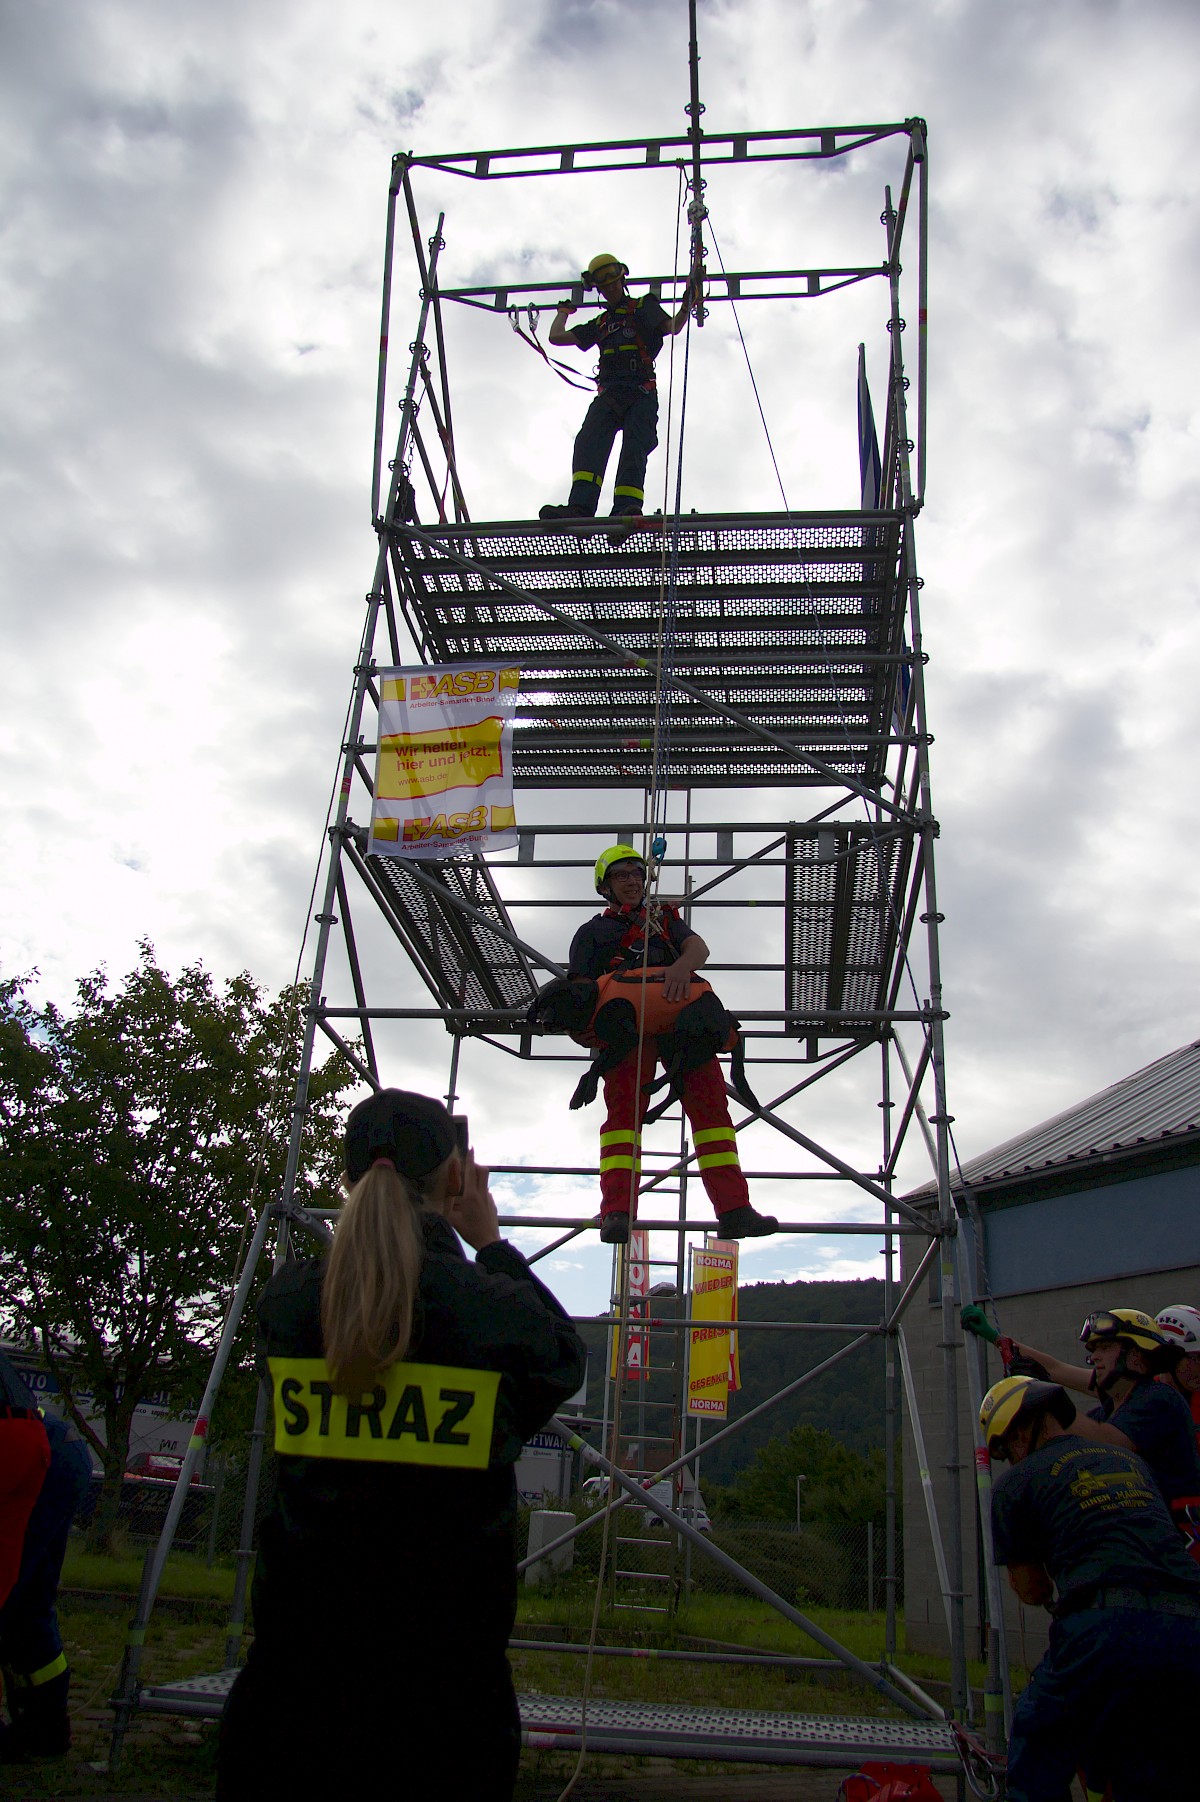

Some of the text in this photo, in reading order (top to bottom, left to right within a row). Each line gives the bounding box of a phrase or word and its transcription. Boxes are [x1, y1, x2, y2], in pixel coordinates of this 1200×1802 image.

[430, 670, 497, 698] ASB
[410, 696, 495, 709] Arbeiter-Samariter-Bund
[395, 740, 467, 758] Wir helfen
[397, 747, 491, 771] hier und jetzt.
[398, 773, 447, 786] www.asb.de
[421, 805, 489, 840] ASB
[697, 1256, 732, 1268] NORMA
[695, 1276, 733, 1295] WIEDER
[691, 1399, 724, 1410] NORMA
